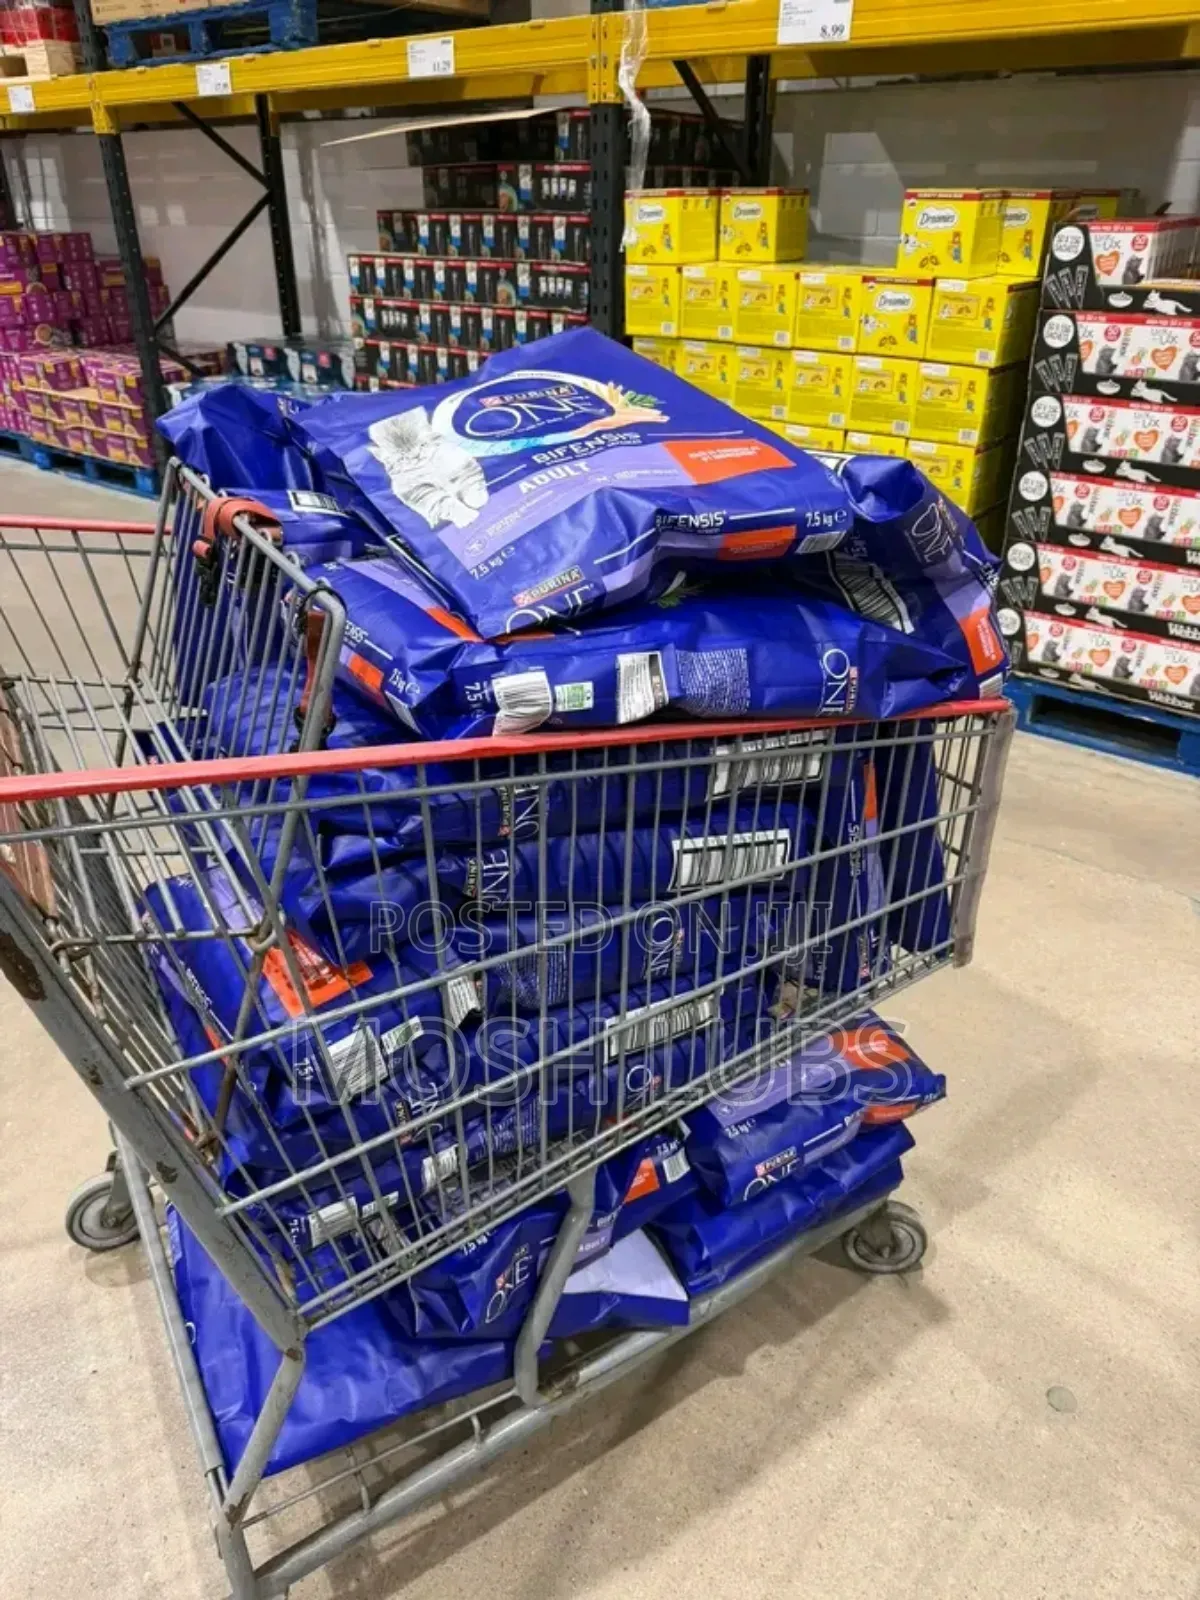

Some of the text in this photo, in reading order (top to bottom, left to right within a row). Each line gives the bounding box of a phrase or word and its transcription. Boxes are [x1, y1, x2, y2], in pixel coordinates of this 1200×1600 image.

[820, 22, 846, 38] 8.99
[919, 211, 957, 225] Dreamies
[879, 293, 912, 306] Dreamies
[502, 385, 572, 402] PURINA
[464, 394, 607, 437] ONE
[531, 431, 643, 465] BIFENSIS
[518, 460, 591, 495] ADULT
[805, 511, 820, 528] 7.5
[822, 514, 834, 528] kg
[469, 554, 504, 580] 7.5 kg
[530, 568, 583, 599] PURINA
[1167, 622, 1200, 642] Webb
[1147, 690, 1195, 711] Webbox
